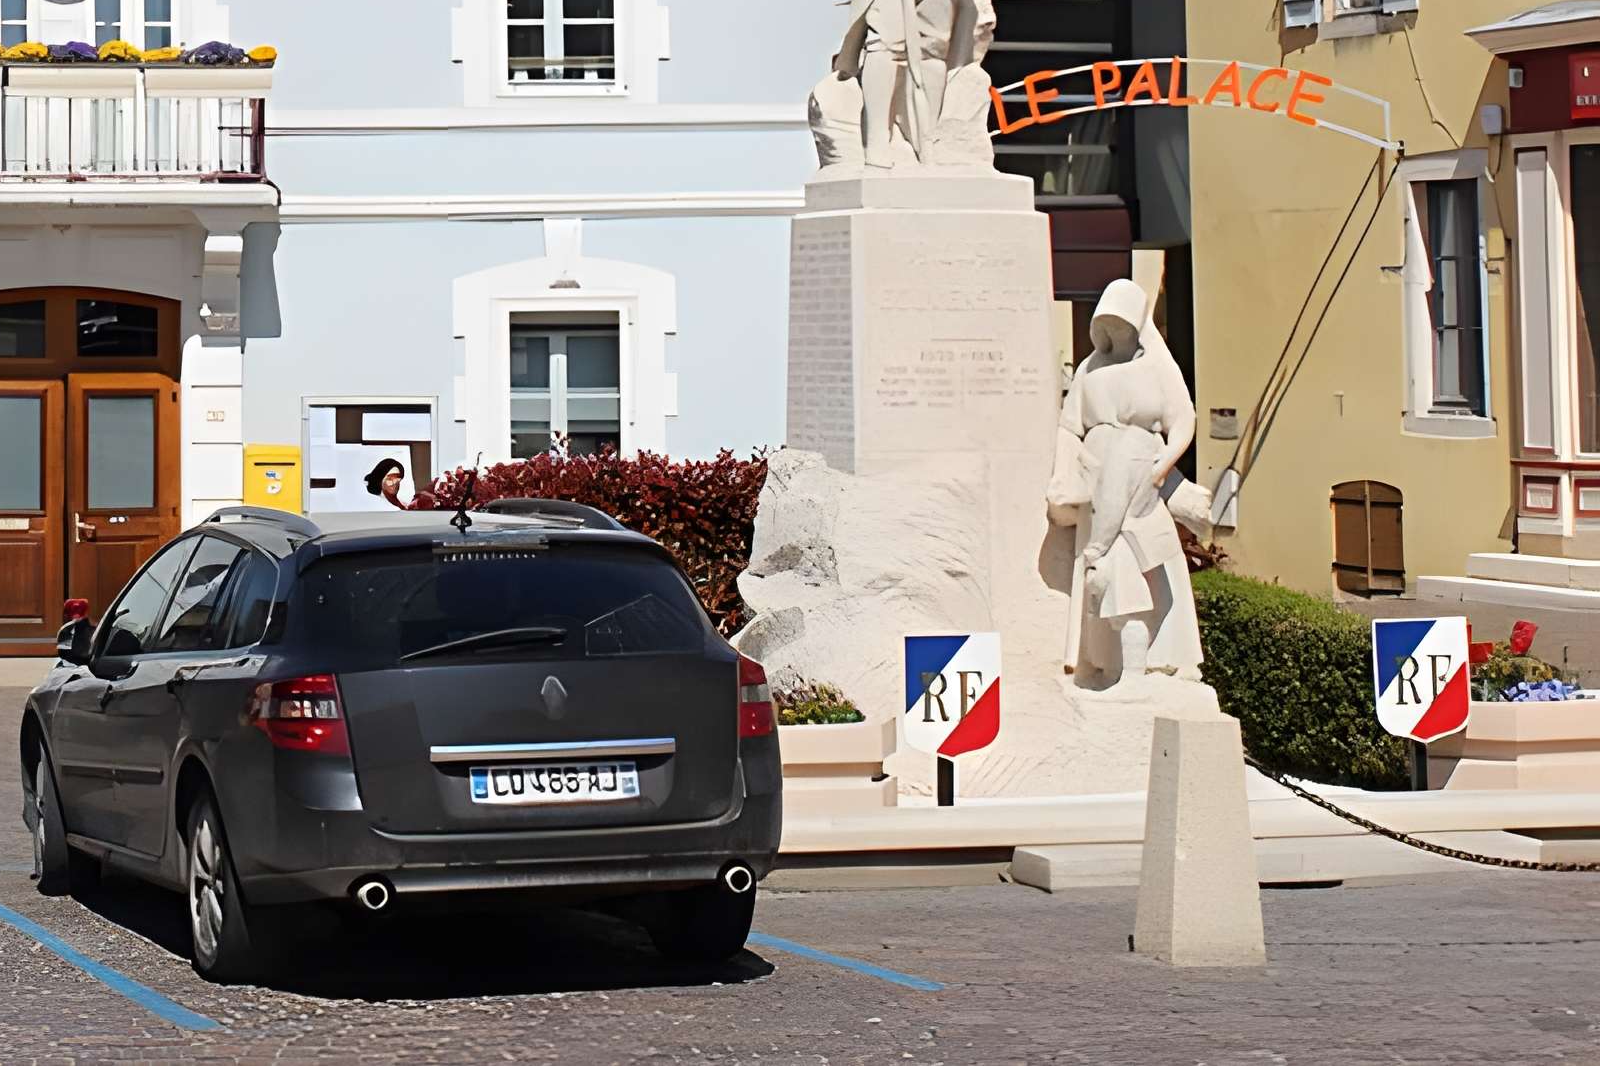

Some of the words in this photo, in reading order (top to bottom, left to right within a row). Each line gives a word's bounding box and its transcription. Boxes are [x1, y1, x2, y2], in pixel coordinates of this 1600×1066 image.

[988, 69, 1065, 134] LE
[1091, 55, 1333, 126] PALACE
[919, 670, 984, 724] RF
[1394, 654, 1453, 706] RF
